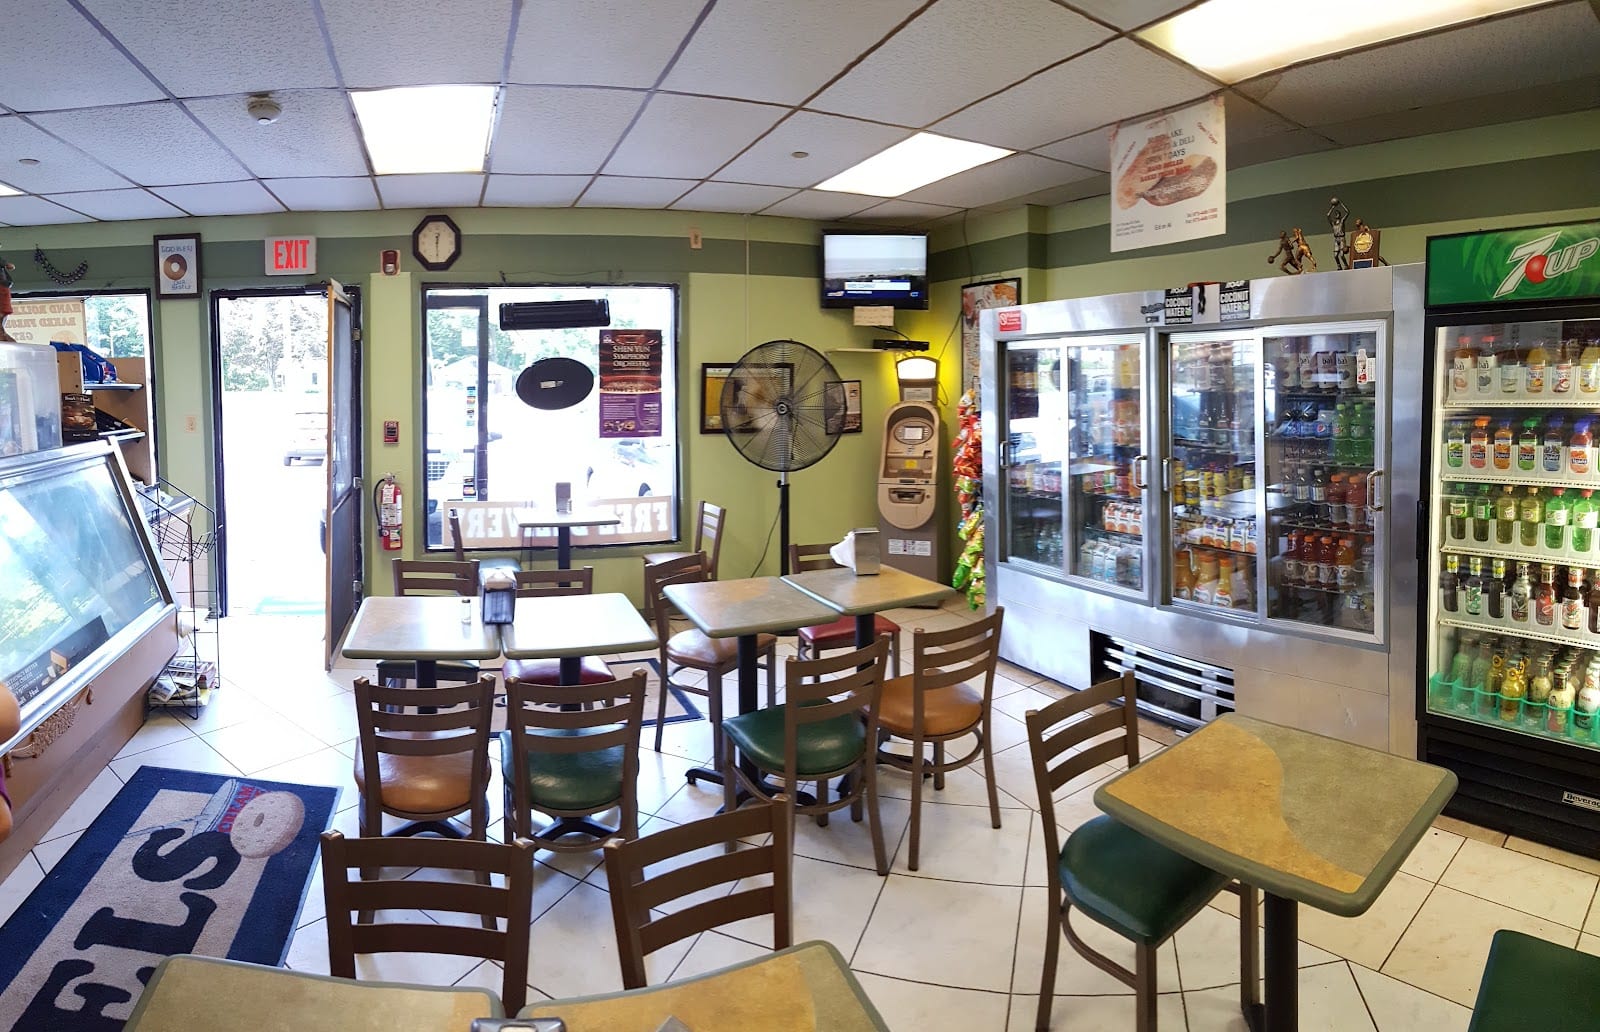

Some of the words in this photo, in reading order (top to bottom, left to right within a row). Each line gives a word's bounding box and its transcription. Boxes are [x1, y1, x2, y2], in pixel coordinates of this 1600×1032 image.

[273, 240, 310, 270] EXIT
[1166, 296, 1192, 307] COCONUT
[1221, 291, 1249, 303] COCONUT
[1221, 302, 1242, 314] WATER
[613, 345, 634, 353] SHEN
[634, 345, 651, 353] YUN
